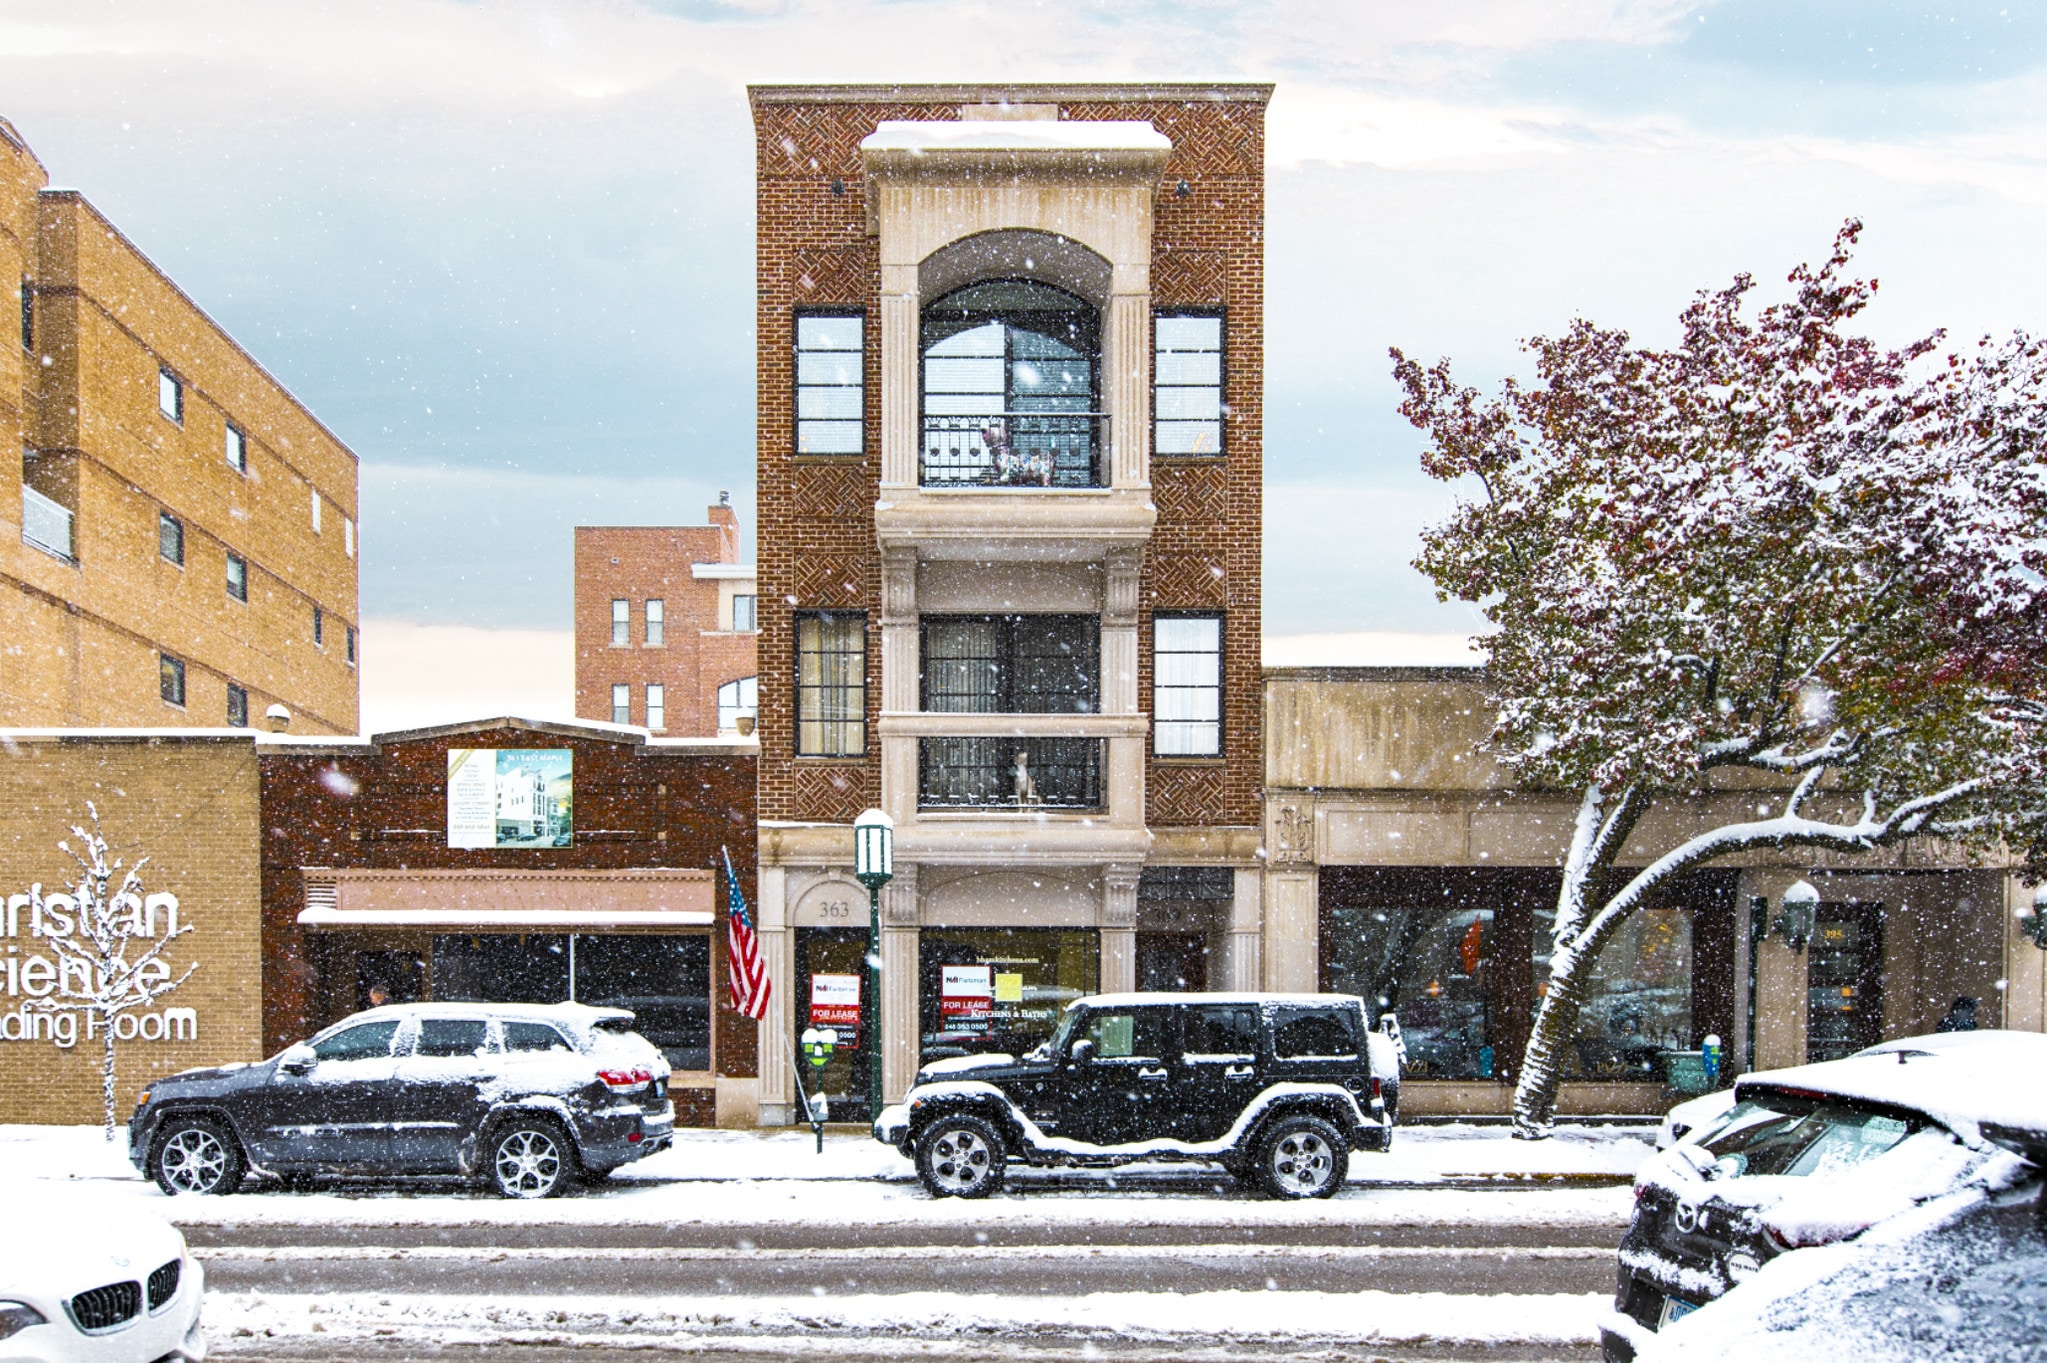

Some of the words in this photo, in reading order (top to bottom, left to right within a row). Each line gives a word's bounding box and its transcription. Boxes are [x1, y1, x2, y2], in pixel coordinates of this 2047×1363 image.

[0, 882, 179, 938] ristian
[819, 901, 849, 917] 363
[1824, 929, 1843, 939] 395
[0, 945, 171, 997] ience
[943, 1001, 961, 1009] FOR
[962, 1001, 990, 1009] LEASE
[813, 1009, 830, 1017] FOR
[831, 1009, 858, 1018] LEASE
[1013, 1010, 1020, 1018] &
[0, 1004, 77, 1048] ding
[944, 1022, 956, 1030] 248
[971, 1022, 989, 1030] 0500
